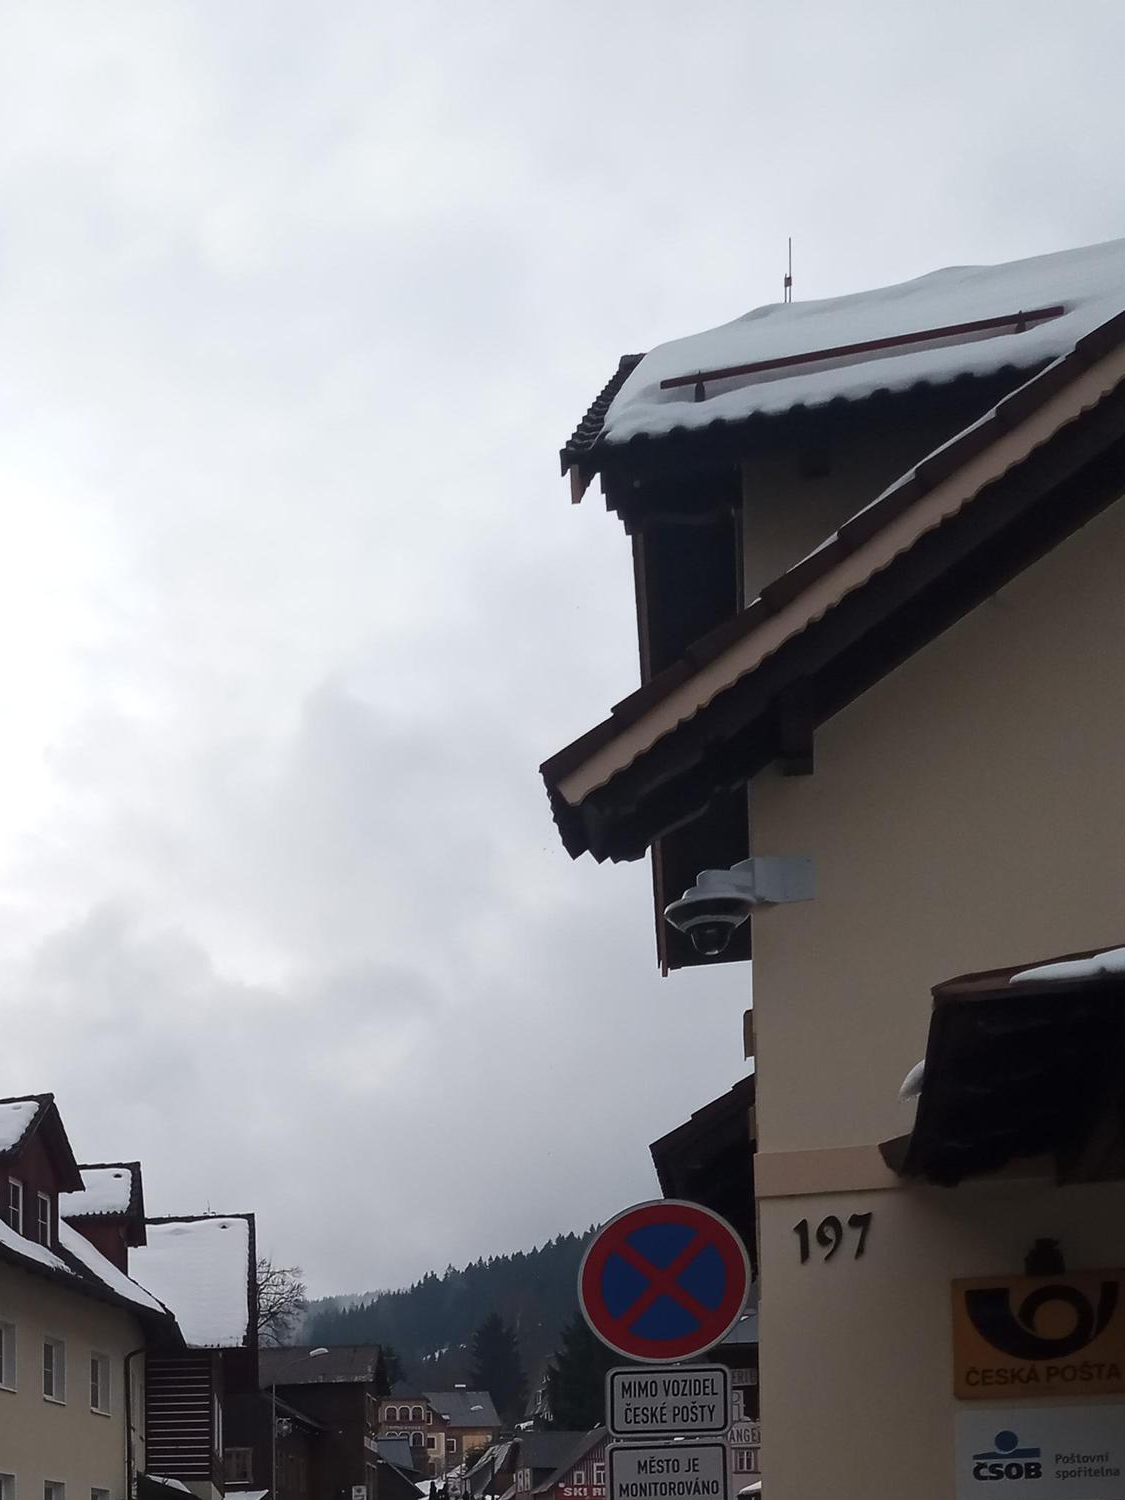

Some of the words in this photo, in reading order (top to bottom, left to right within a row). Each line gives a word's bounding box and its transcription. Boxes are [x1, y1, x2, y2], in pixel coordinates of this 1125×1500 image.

[793, 1211, 873, 1264] 197
[964, 1364, 1041, 1387] ČESKÁ
[1046, 1360, 1122, 1383] POŠTA
[621, 1380, 658, 1398] MIMO
[663, 1378, 718, 1397] VOZIDEL
[625, 1402, 668, 1424] ČESKÉ
[672, 1401, 716, 1422] POŠTY
[637, 1456, 680, 1474] MĚSTO
[685, 1457, 700, 1473] JE
[1054, 1452, 1110, 1464] Poštovní
[972, 1462, 1042, 1481] ČSOB
[1055, 1467, 1121, 1480] spořitelna
[563, 1487, 588, 1497] SKI
[619, 1477, 720, 1497] MONITOROVÁNO
